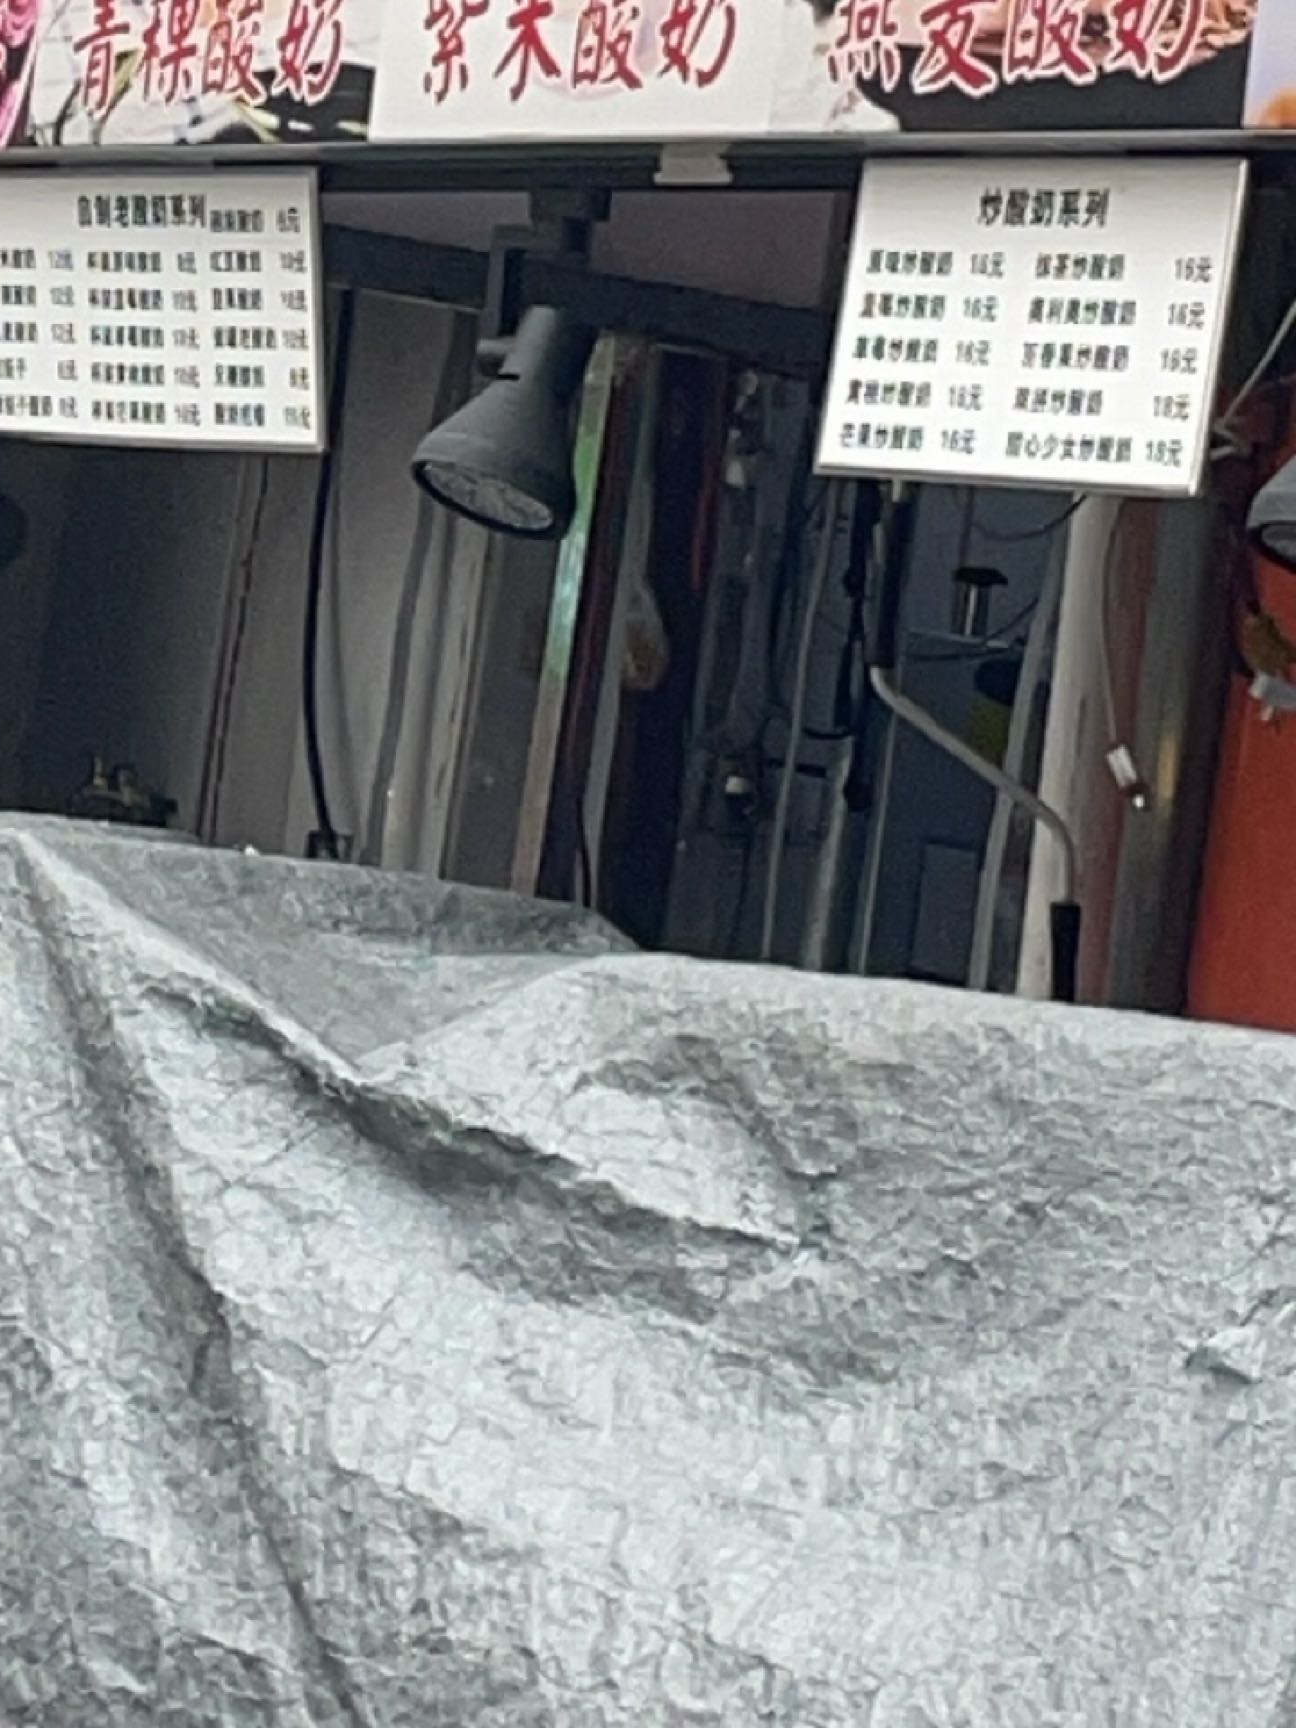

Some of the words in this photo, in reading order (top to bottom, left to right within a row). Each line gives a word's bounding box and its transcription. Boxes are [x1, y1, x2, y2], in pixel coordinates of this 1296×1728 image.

[977, 187, 1111, 227] 炒酸奶系列
